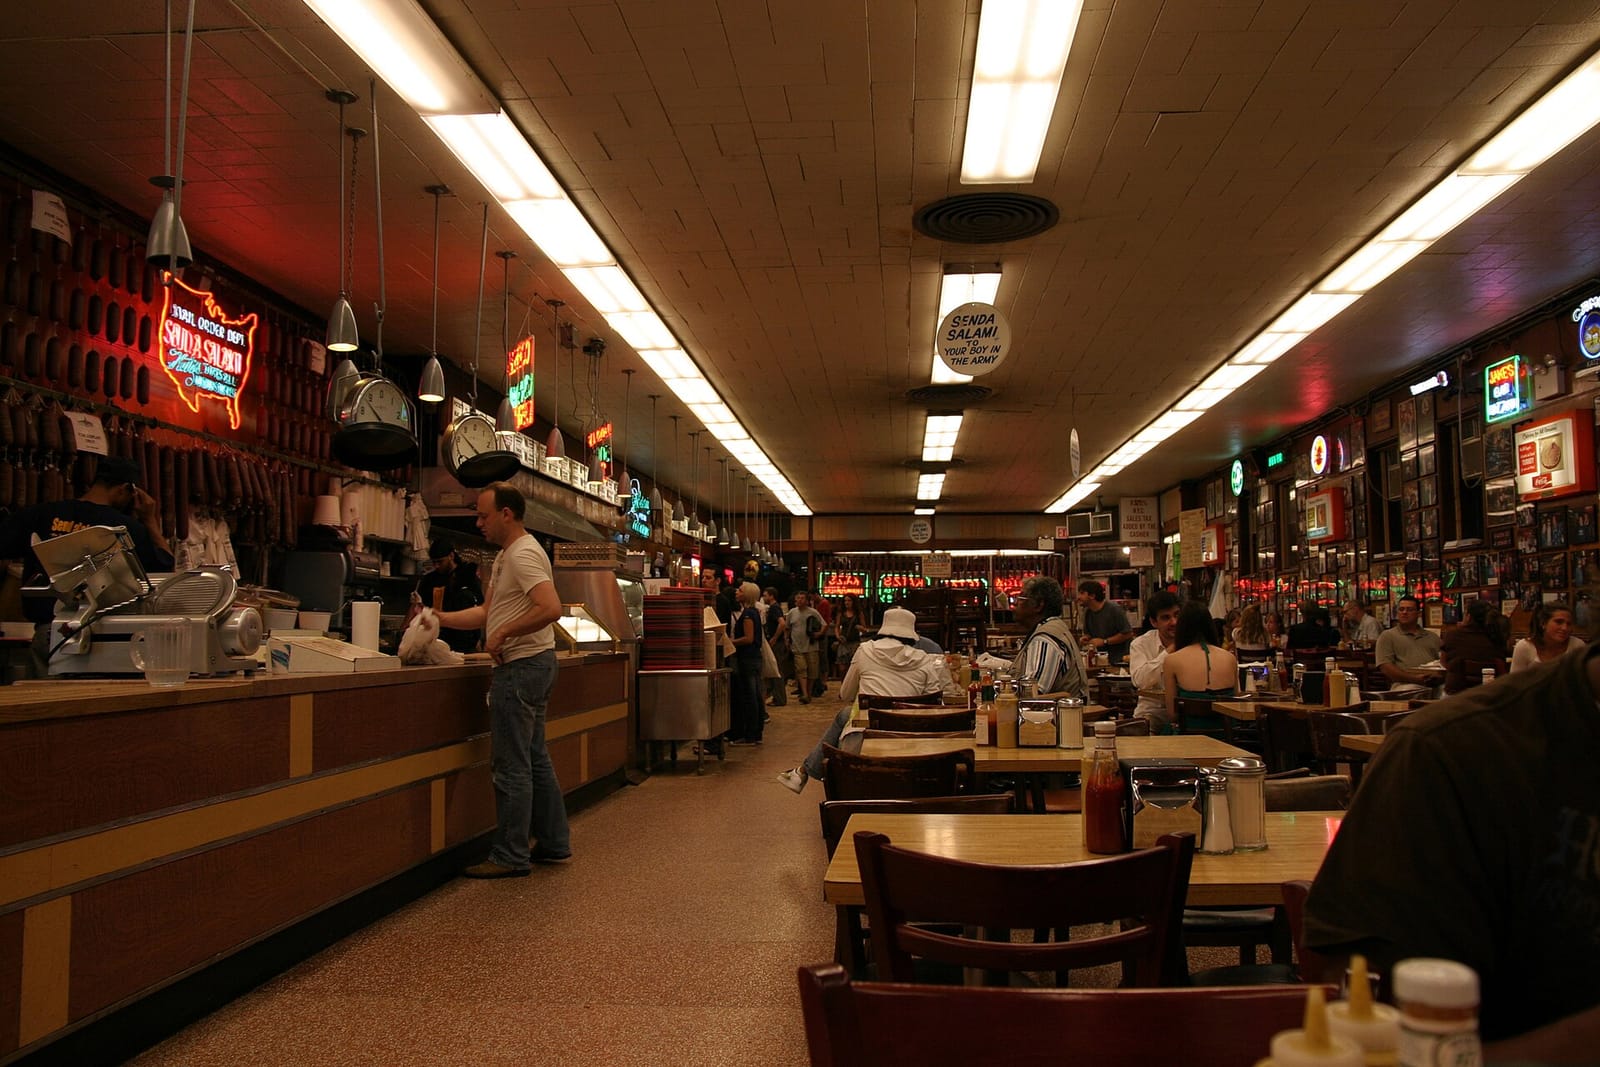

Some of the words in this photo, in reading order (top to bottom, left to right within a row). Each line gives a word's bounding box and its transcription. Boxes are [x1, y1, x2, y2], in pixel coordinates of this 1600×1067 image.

[172, 304, 196, 326] MAIL
[198, 317, 225, 338] ORDER
[946, 326, 998, 341] SALAMI
[202, 340, 242, 374] SALAMI
[944, 347, 967, 356] YOUR
[970, 345, 989, 355] BOY
[991, 345, 1001, 353] IN
[950, 357, 968, 365] THE
[970, 355, 999, 365] ARMY
